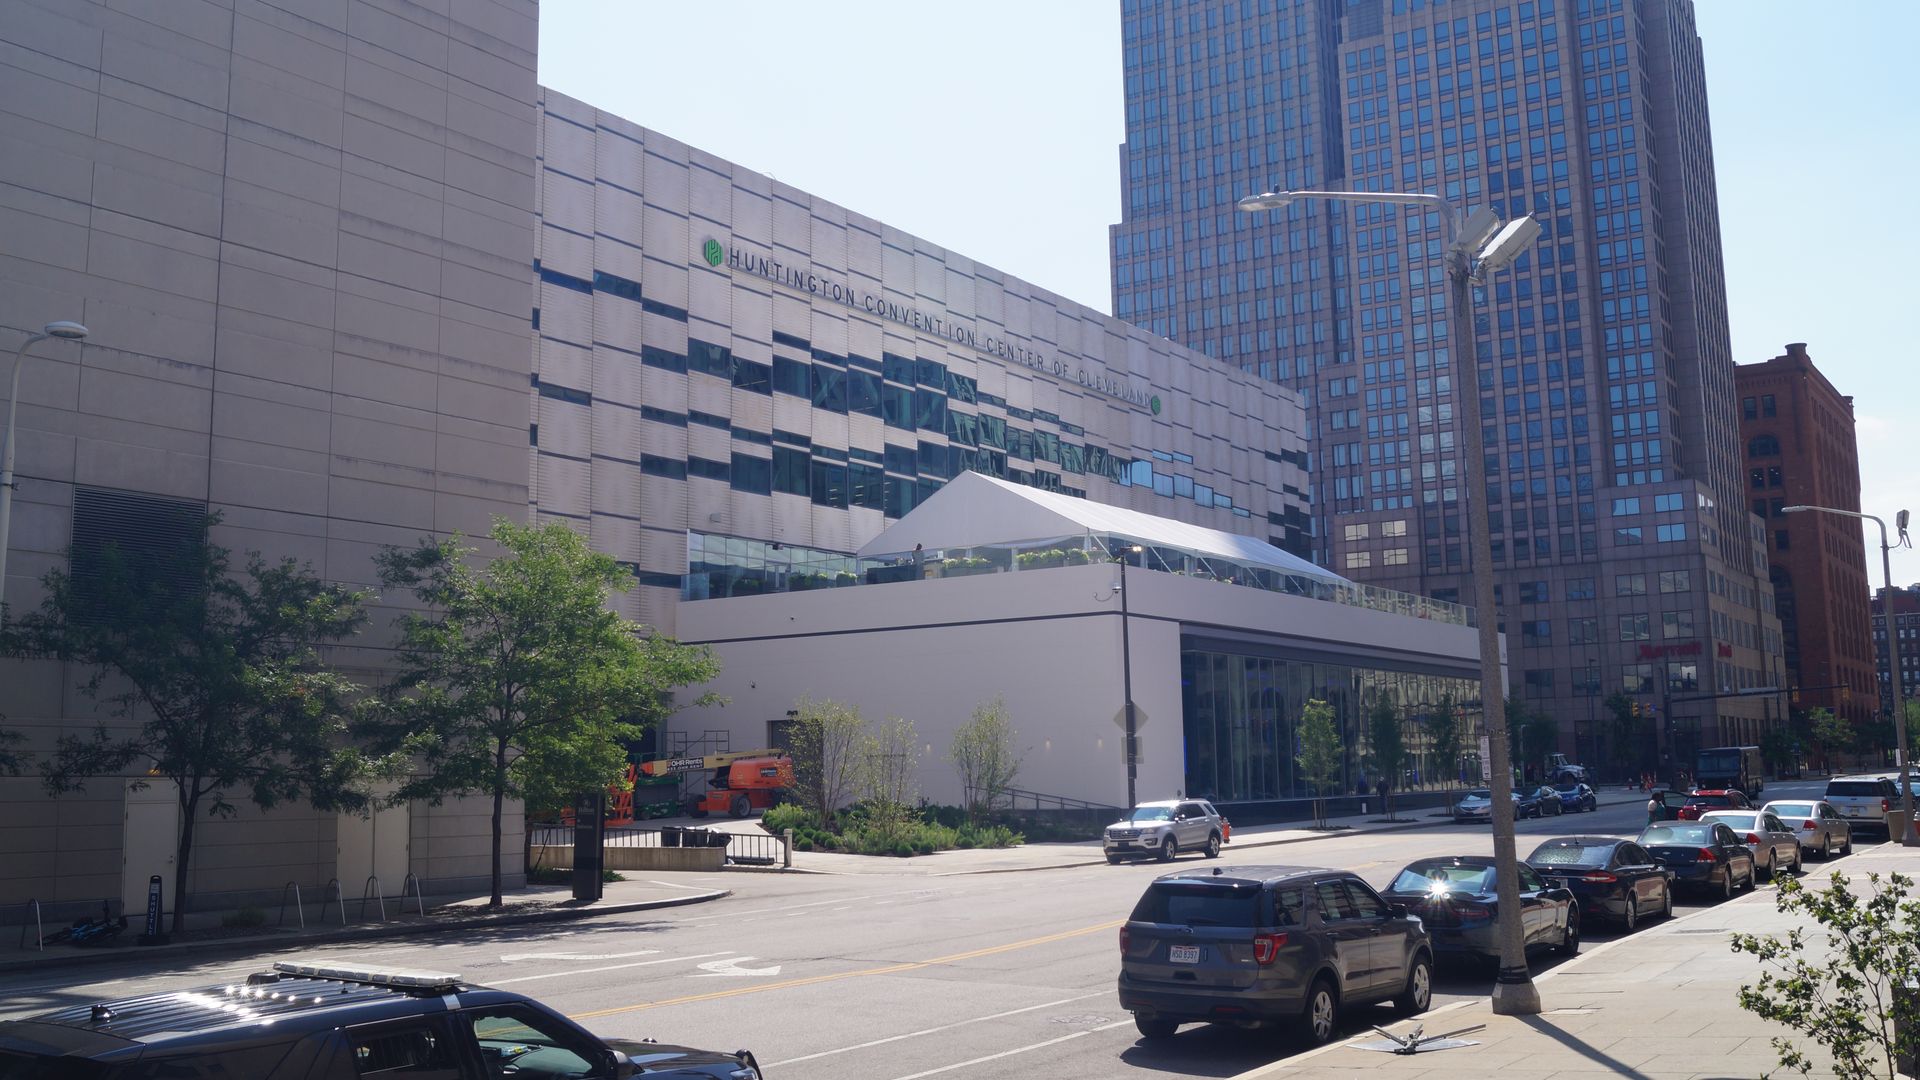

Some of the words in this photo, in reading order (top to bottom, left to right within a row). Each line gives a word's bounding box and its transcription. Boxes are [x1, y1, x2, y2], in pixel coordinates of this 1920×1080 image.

[729, 247, 855, 306] HUNTINGTON
[865, 295, 975, 347] CONVENTION
[986, 338, 1044, 370] CENTER
[1053, 361, 1069, 376] OF
[1077, 369, 1151, 405] CLEVELAND
[148, 895, 157, 936] SHUTTLE
